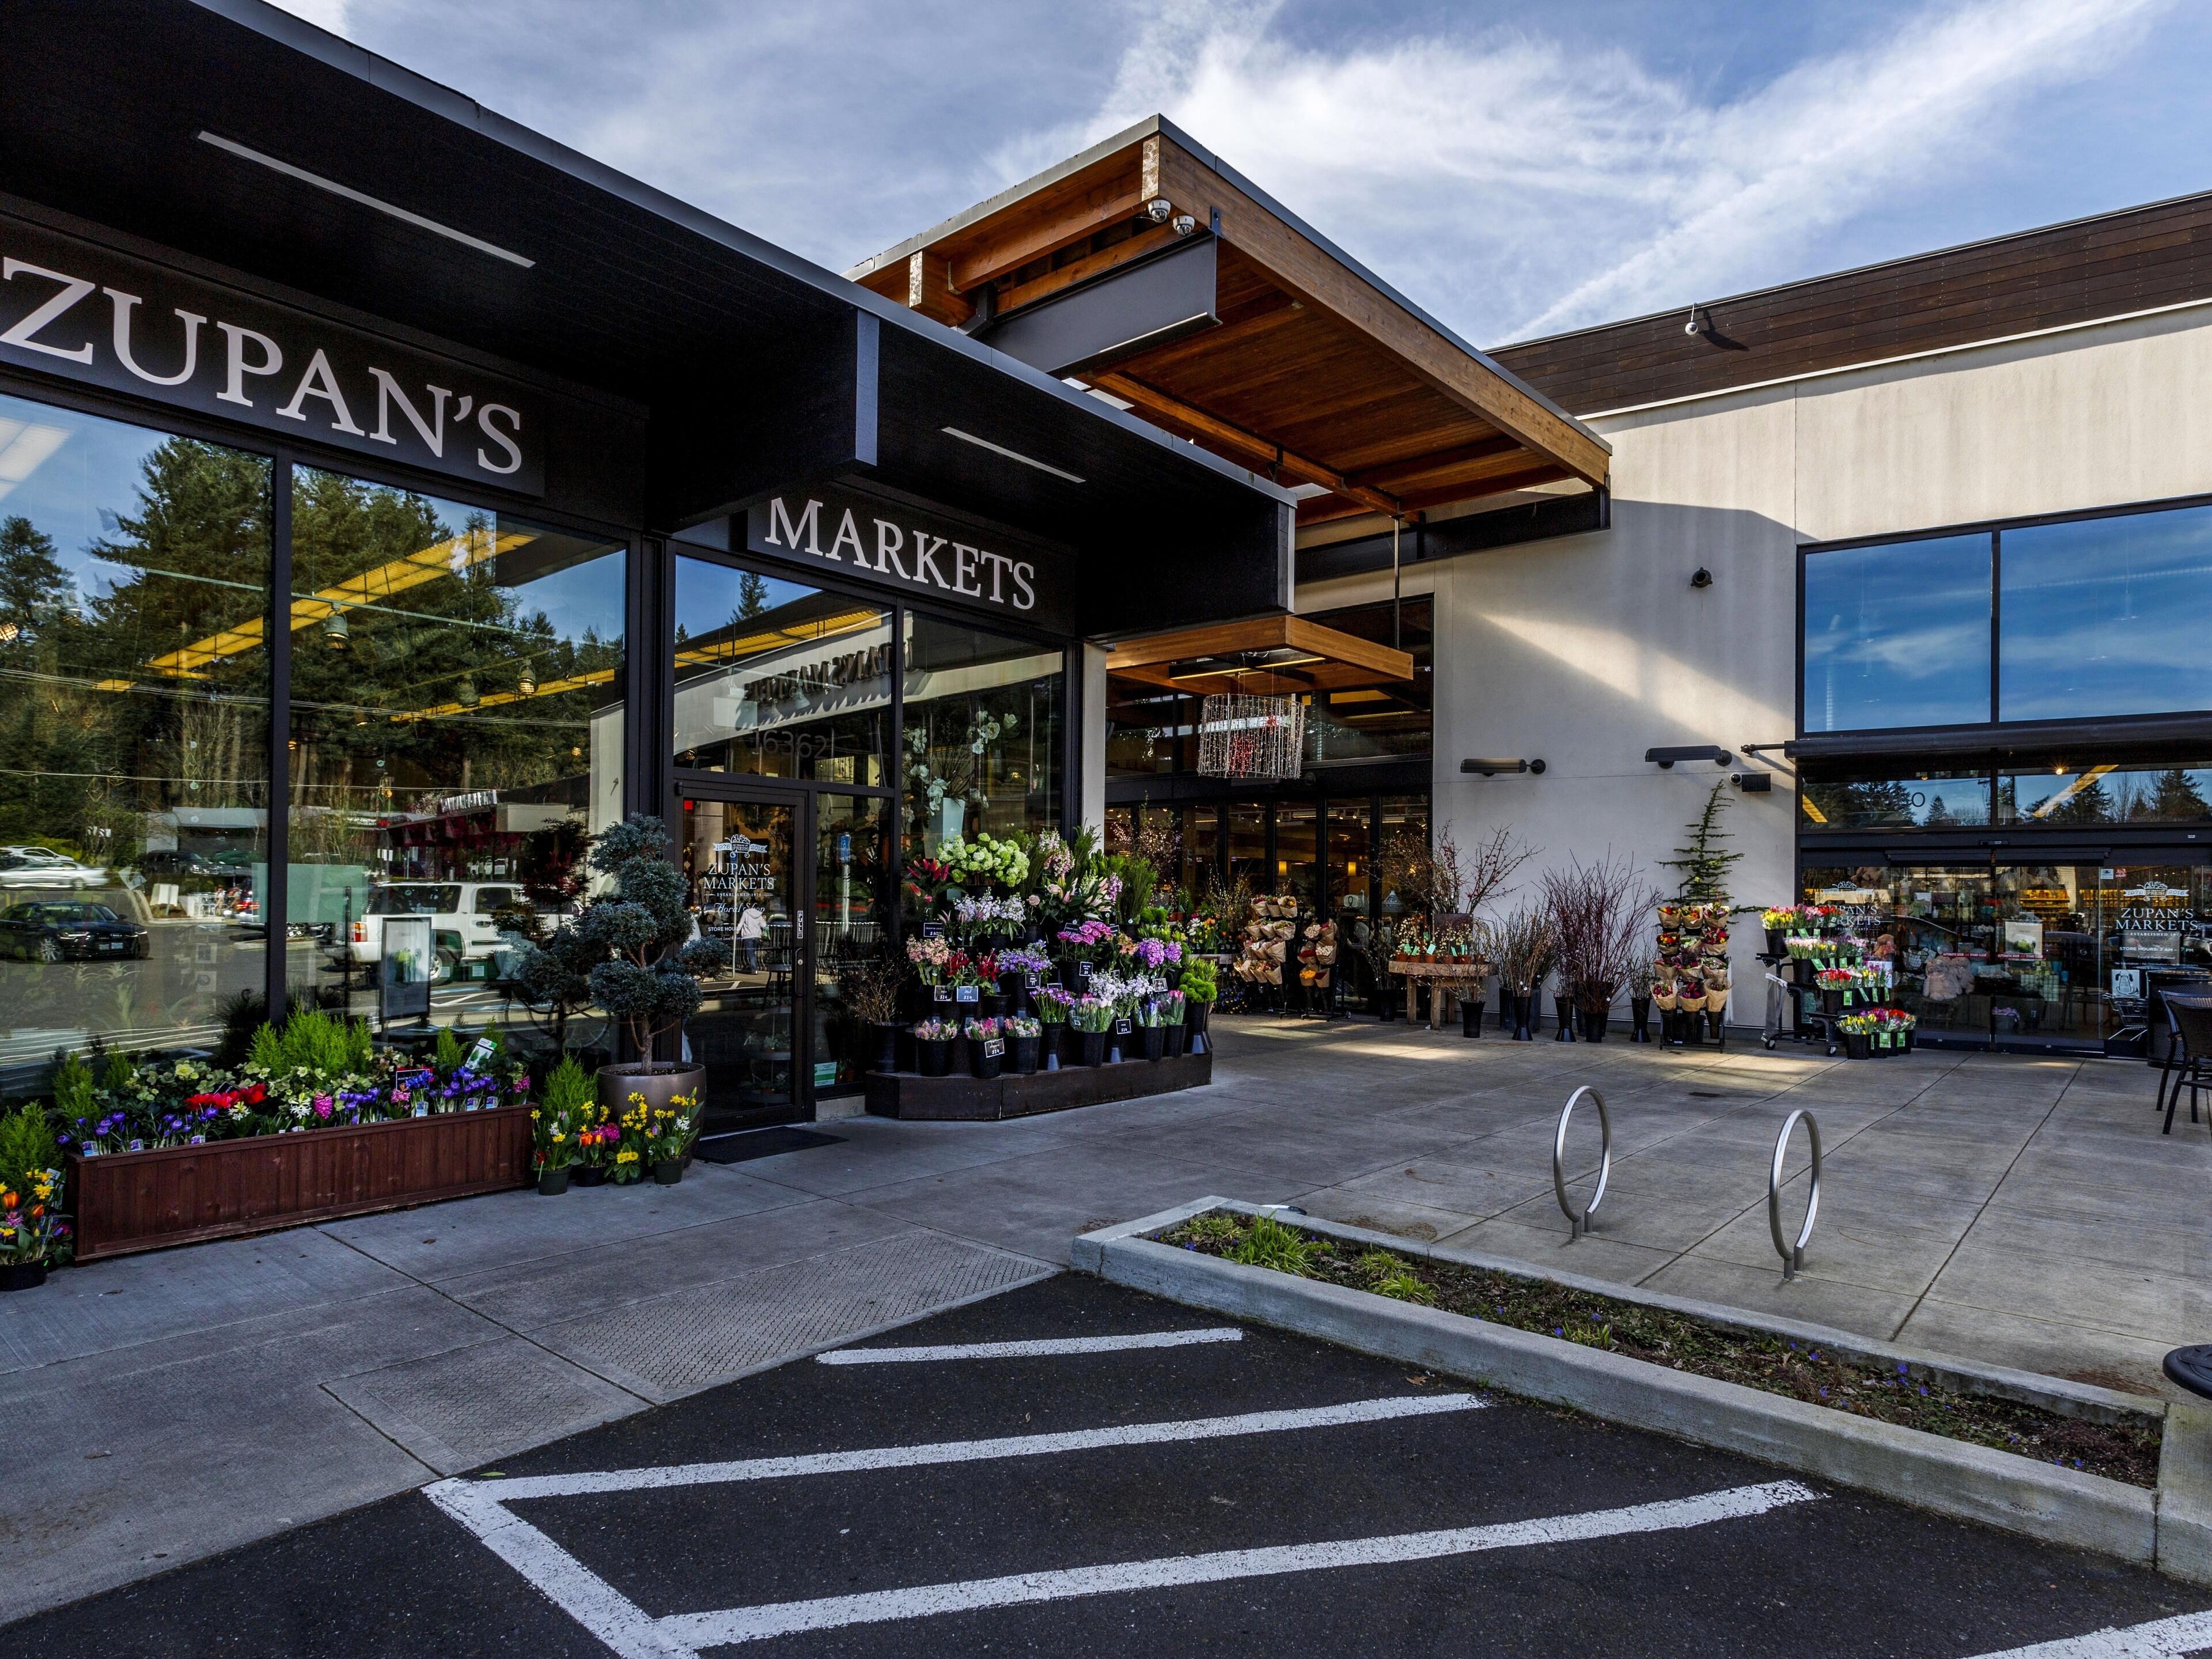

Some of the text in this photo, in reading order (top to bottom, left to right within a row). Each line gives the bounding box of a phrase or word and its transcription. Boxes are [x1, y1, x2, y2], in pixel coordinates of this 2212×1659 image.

[0, 256, 522, 474] ZUPAN'S
[765, 497, 1035, 610] MARKETS
[753, 728, 827, 759] 16362
[709, 862, 770, 876] ZUPAN'S
[703, 877, 774, 890] MARKETS
[714, 903, 744, 912] Floral
[2121, 908, 2194, 919] ZUPAN'S
[2116, 919, 2198, 930] MARKETS
